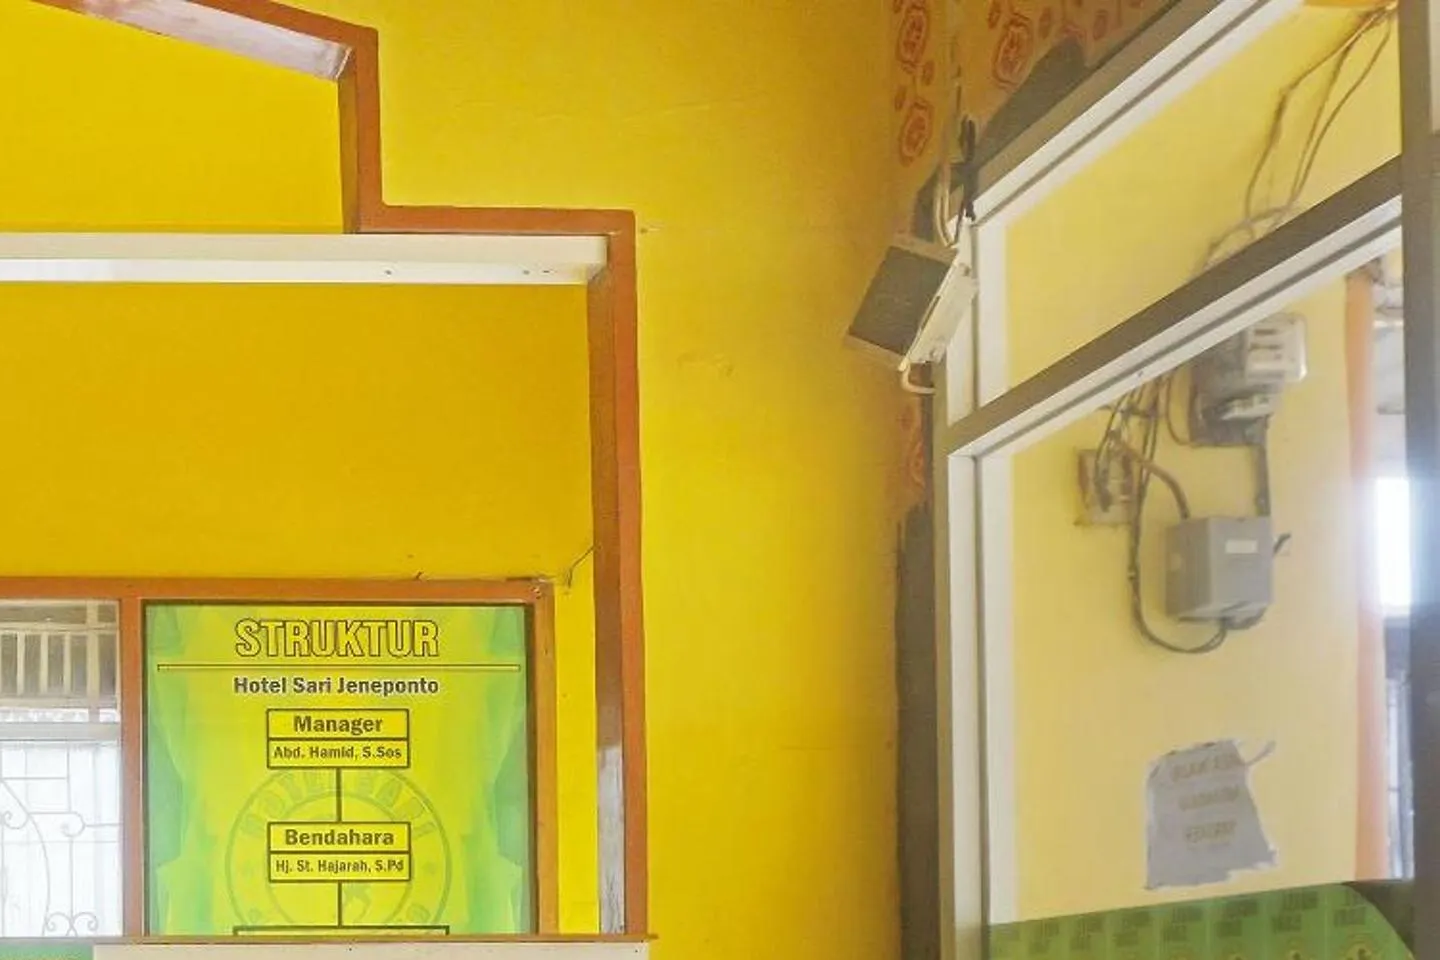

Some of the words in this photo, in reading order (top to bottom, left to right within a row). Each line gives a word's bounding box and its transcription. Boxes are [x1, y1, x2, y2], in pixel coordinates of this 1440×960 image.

[234, 617, 440, 658] STRUKTUR
[233, 676, 287, 694] Hotel
[292, 676, 332, 694] Sari
[336, 676, 440, 698] Jeneponto
[293, 714, 384, 736] Manager
[273, 745, 306, 759] Abd.
[309, 745, 359, 761] Hamid,
[361, 745, 403, 759] S.Sos
[284, 828, 395, 846] Bendahara
[275, 859, 293, 874] Hj.
[374, 859, 405, 872] S.Pd
